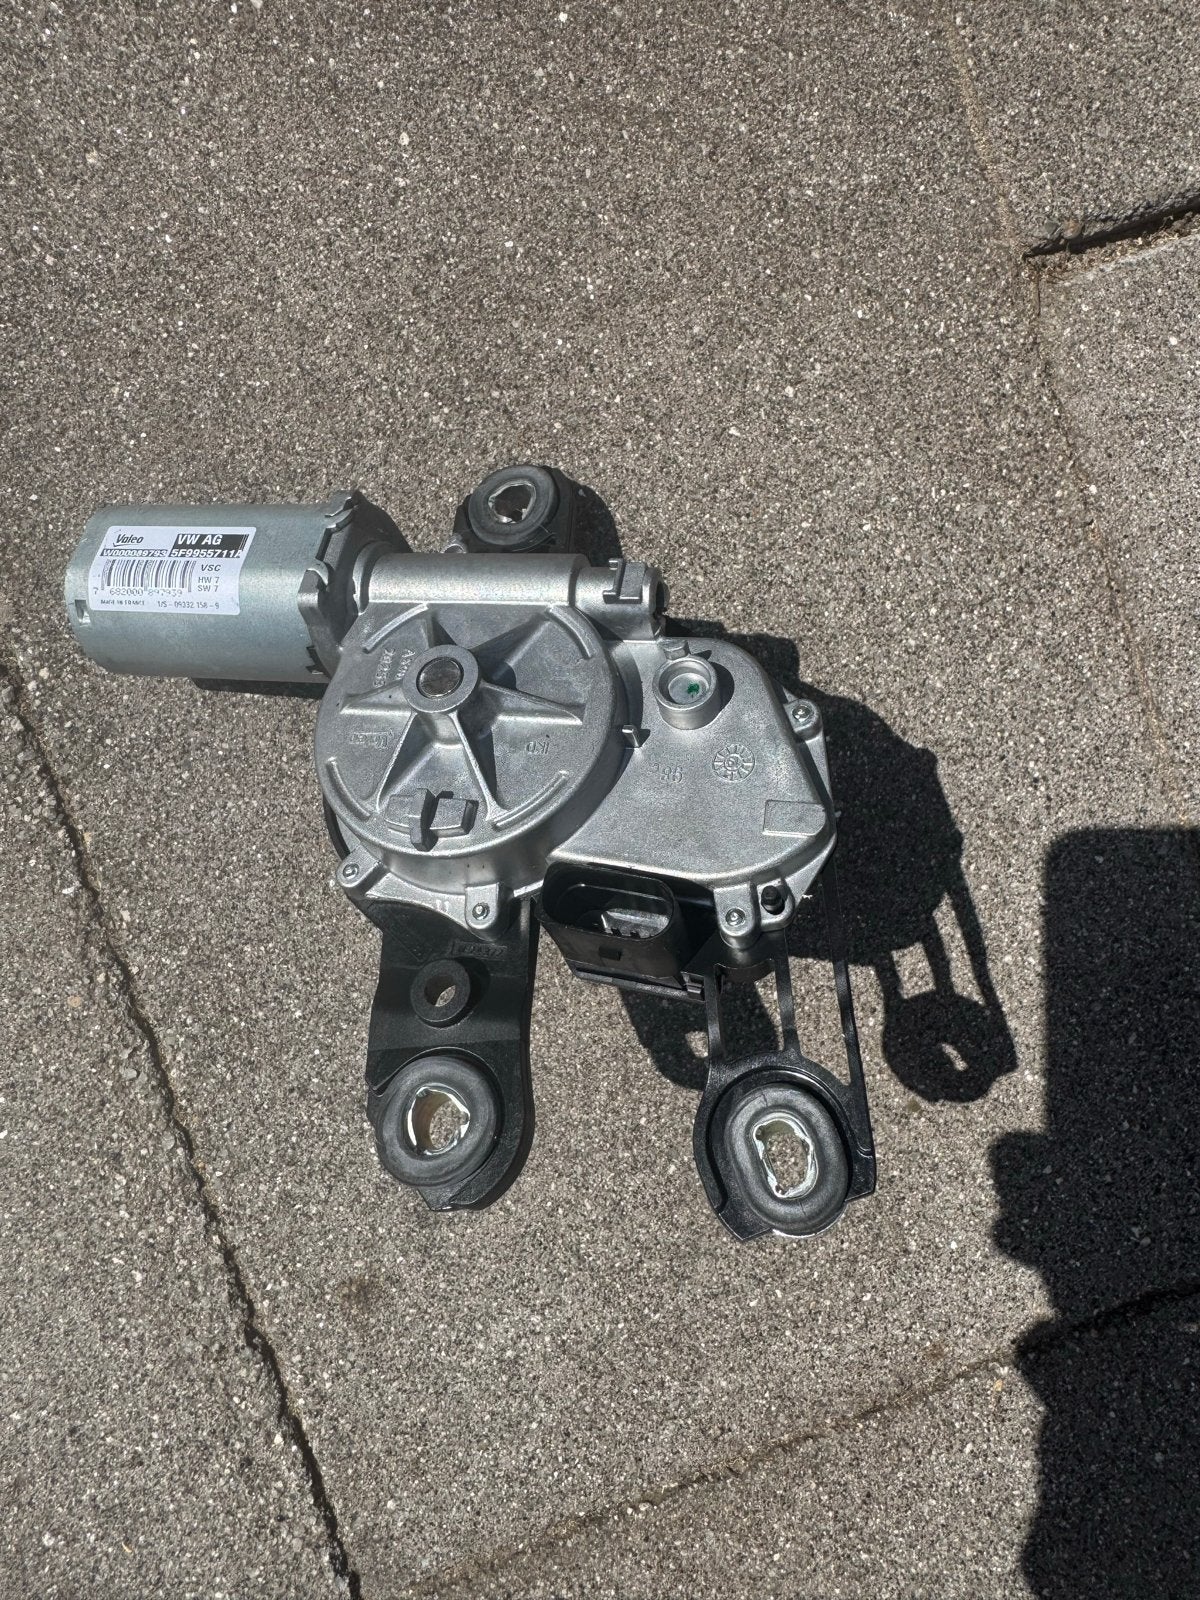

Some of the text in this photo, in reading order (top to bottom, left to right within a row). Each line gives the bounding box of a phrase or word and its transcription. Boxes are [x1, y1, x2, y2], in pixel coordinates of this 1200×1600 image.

[115, 533, 144, 545] Valeo
[177, 534, 223, 545] VW AG
[102, 549, 168, 557] W000089793
[170, 549, 241, 558] 5F9955711A
[201, 564, 221, 572] VSC
[109, 588, 143, 596] 682000
